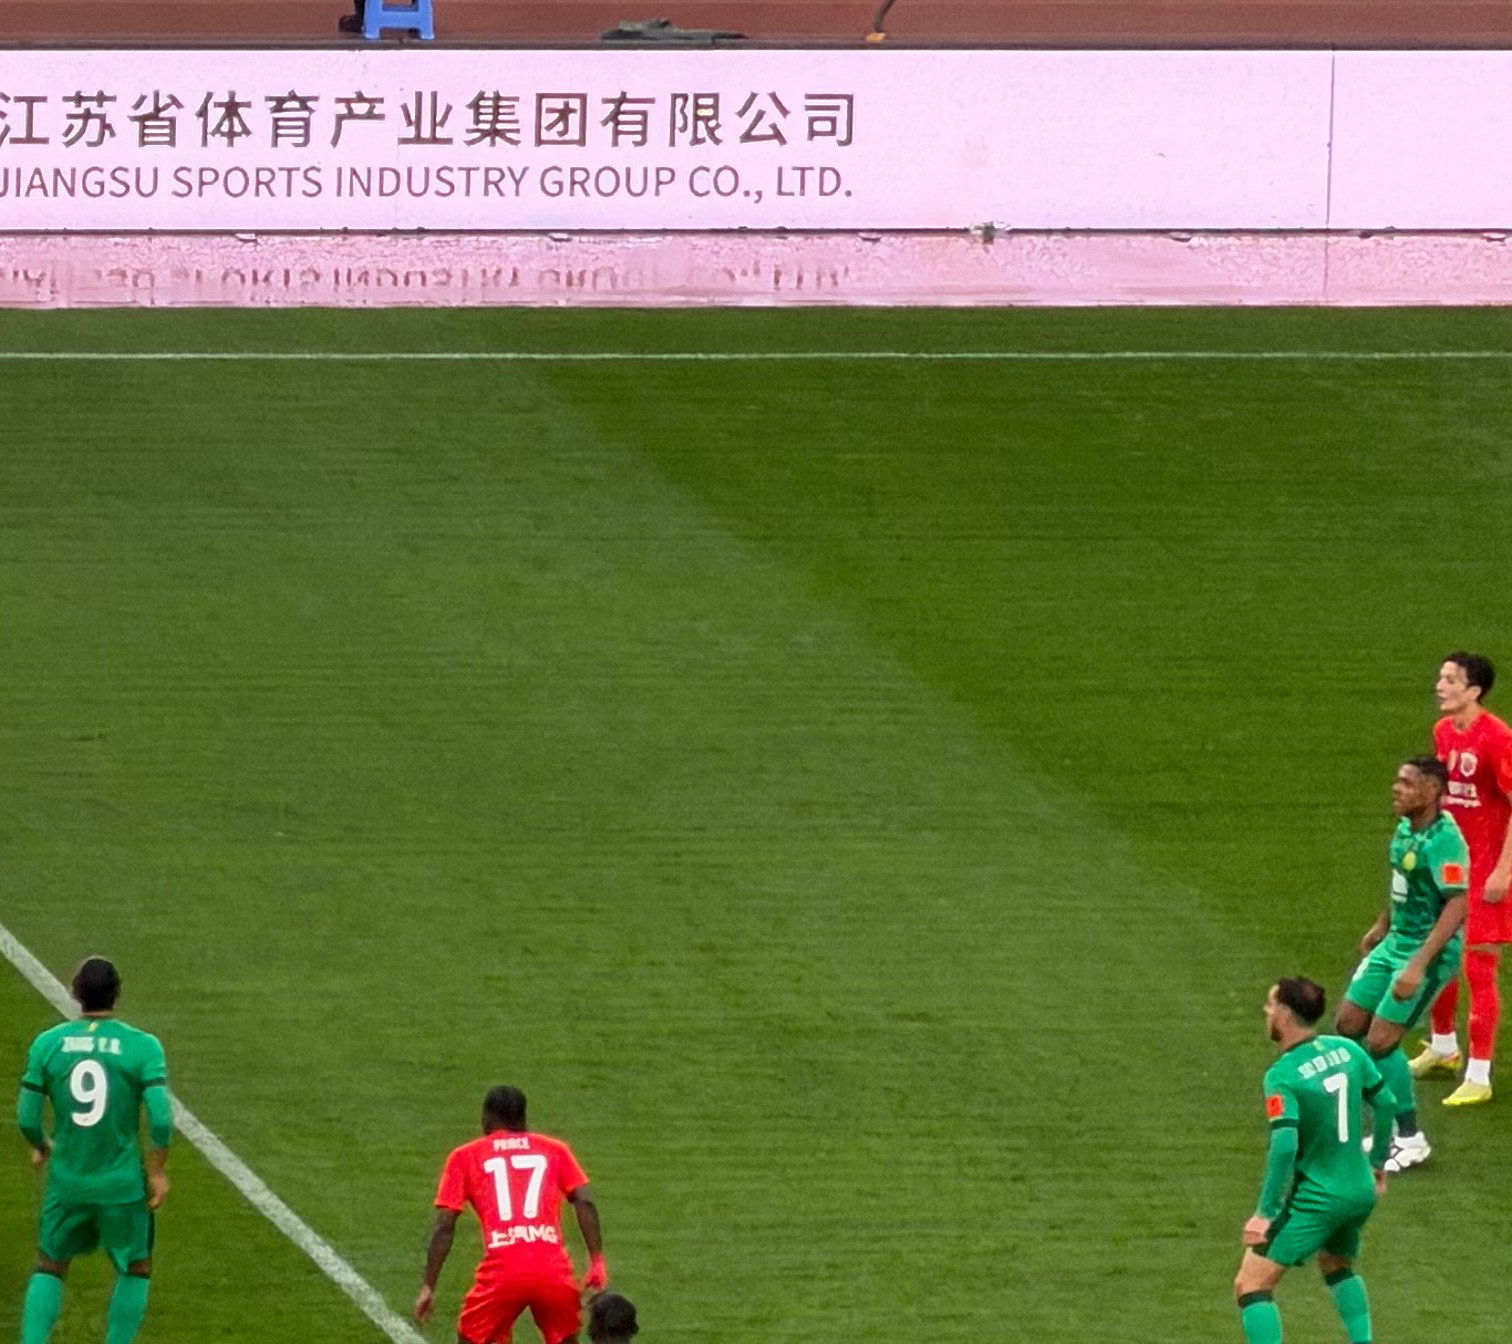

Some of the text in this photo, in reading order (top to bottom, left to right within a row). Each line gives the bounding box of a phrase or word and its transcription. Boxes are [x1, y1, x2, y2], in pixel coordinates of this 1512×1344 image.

[171, 165, 323, 199] SPORTS
[336, 164, 530, 198] INDUSTRY
[539, 165, 676, 198] GROUP
[688, 164, 763, 204] CO.,
[776, 166, 852, 198] LTD.
[70, 1059, 108, 1127] 9
[483, 1154, 548, 1221] 17
